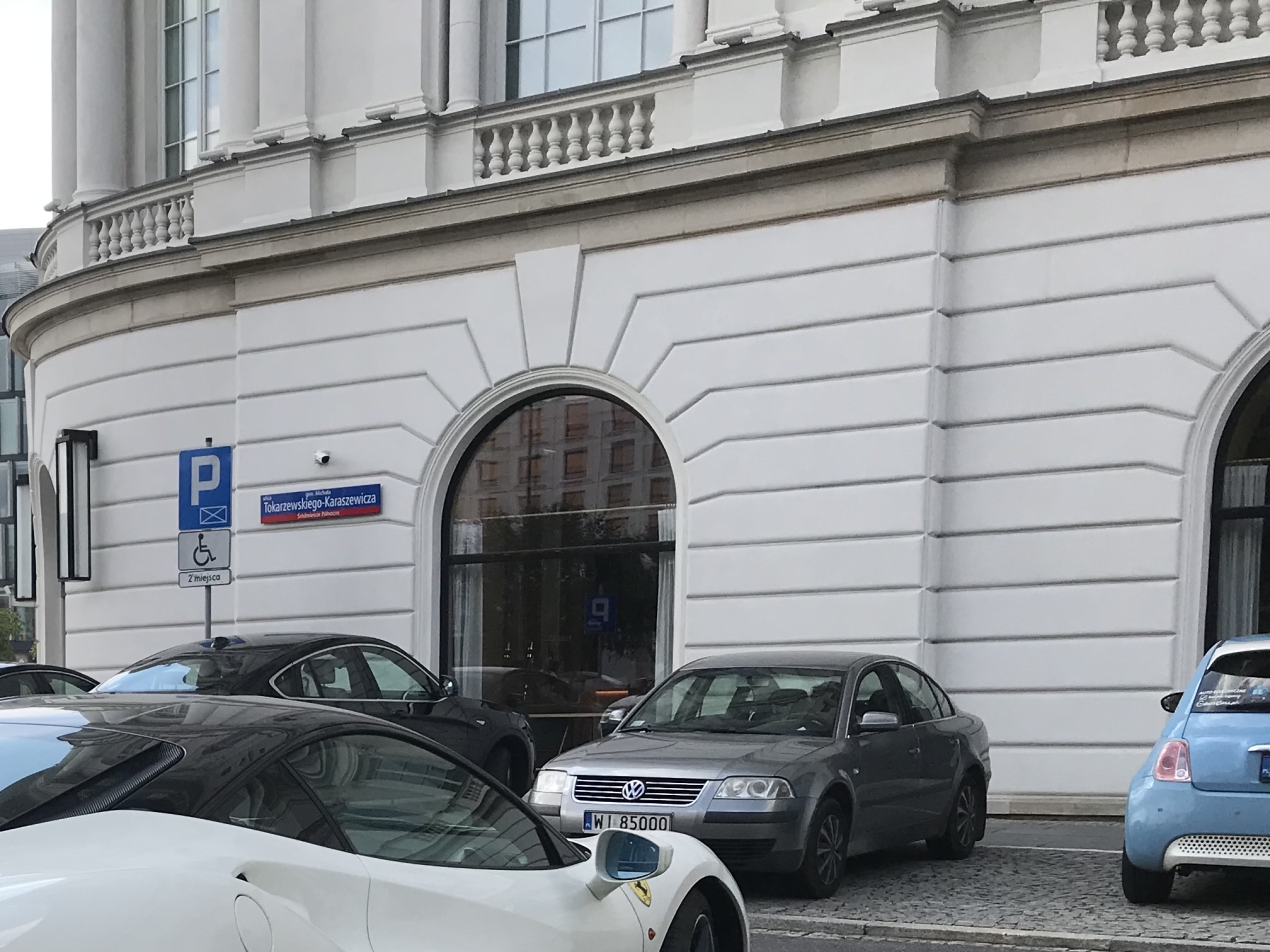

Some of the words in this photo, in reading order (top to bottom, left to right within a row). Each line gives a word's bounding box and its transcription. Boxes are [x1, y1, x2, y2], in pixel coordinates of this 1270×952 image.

[191, 454, 221, 506] P
[264, 493, 377, 514] Tokarzewskiego-Karaszewicza
[187, 574, 193, 583] 2
[194, 574, 221, 585] miejsca
[594, 814, 611, 829] WI
[620, 815, 668, 831] 85000
